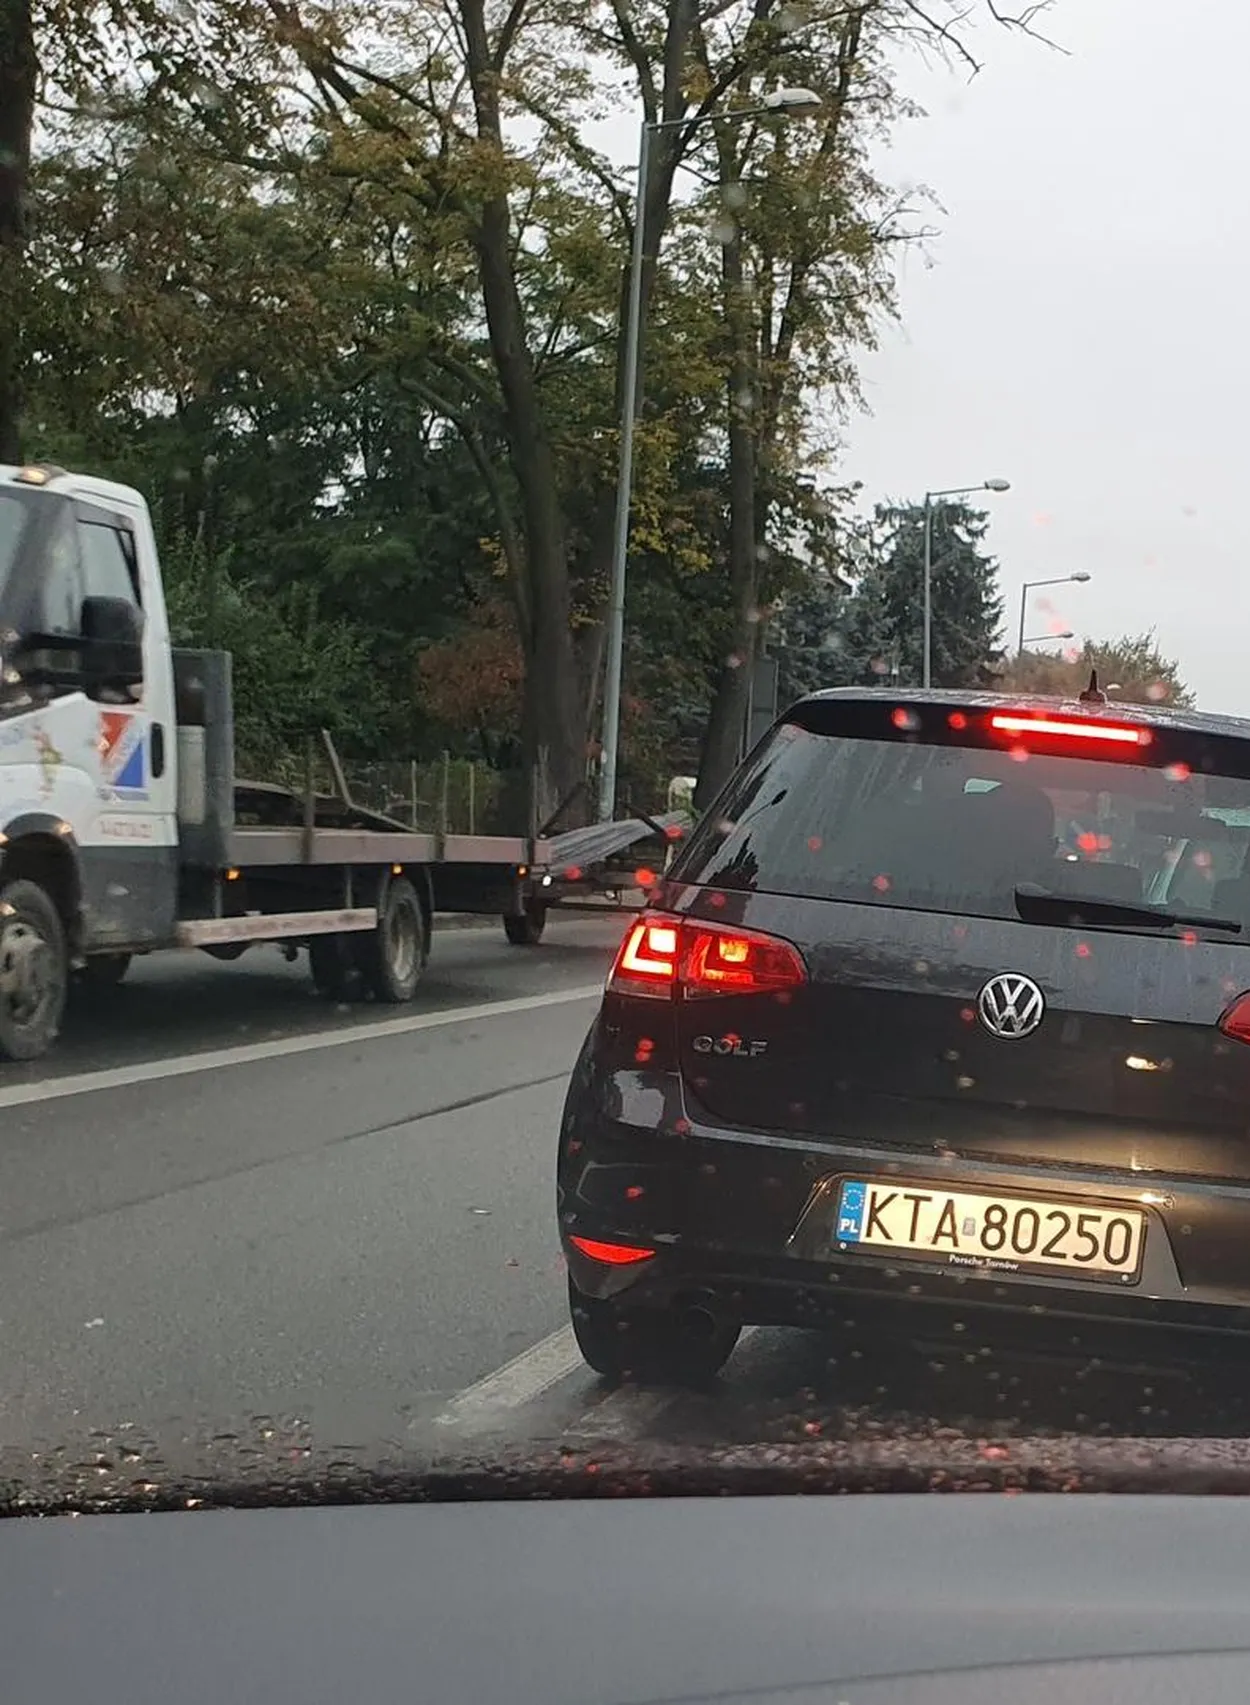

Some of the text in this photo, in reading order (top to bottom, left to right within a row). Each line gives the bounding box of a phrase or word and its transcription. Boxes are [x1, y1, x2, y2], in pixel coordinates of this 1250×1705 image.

[692, 1036, 768, 1056] GOLF
[840, 1219, 859, 1234] PL
[865, 1191, 1133, 1266] KTA 80250
[949, 1253, 984, 1266] Porsche
